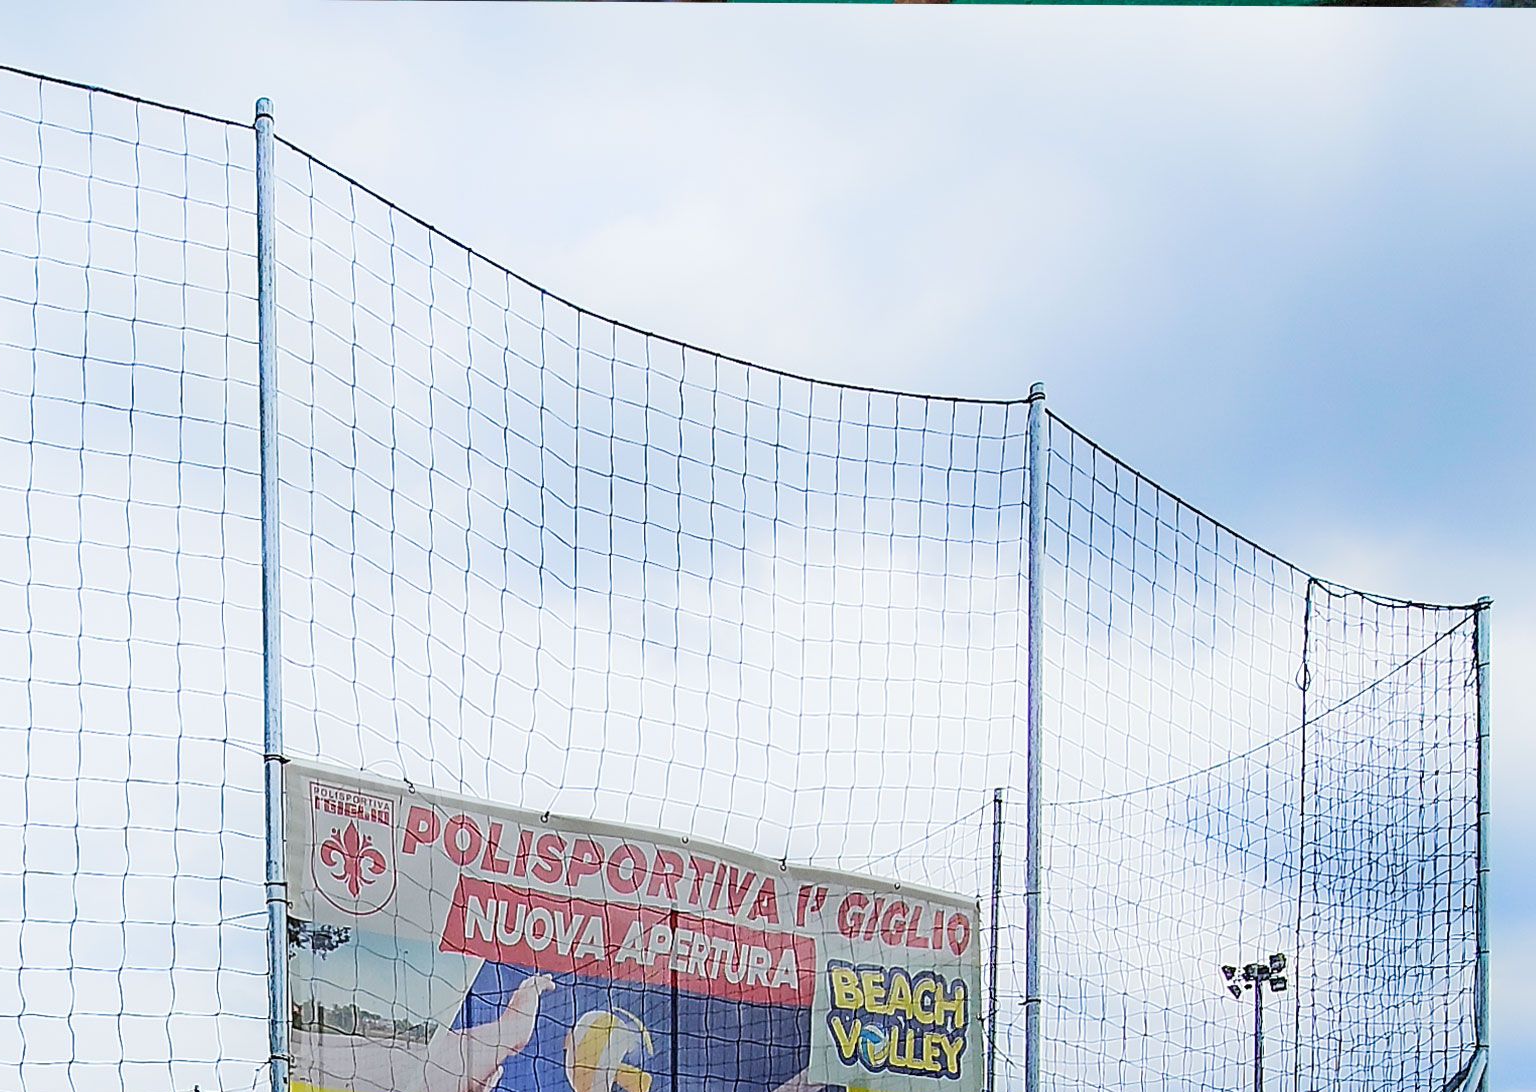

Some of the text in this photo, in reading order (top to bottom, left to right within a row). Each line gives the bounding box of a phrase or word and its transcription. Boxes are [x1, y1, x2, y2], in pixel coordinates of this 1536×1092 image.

[313, 786, 390, 811] POLISPORTIVA
[401, 805, 780, 925] POLISPORTIVA
[836, 891, 971, 956] GIGLIO
[465, 896, 798, 990] NUOVA APERTURA
[831, 966, 965, 1029] BEACH
[830, 1016, 965, 1073] VOLLEY
